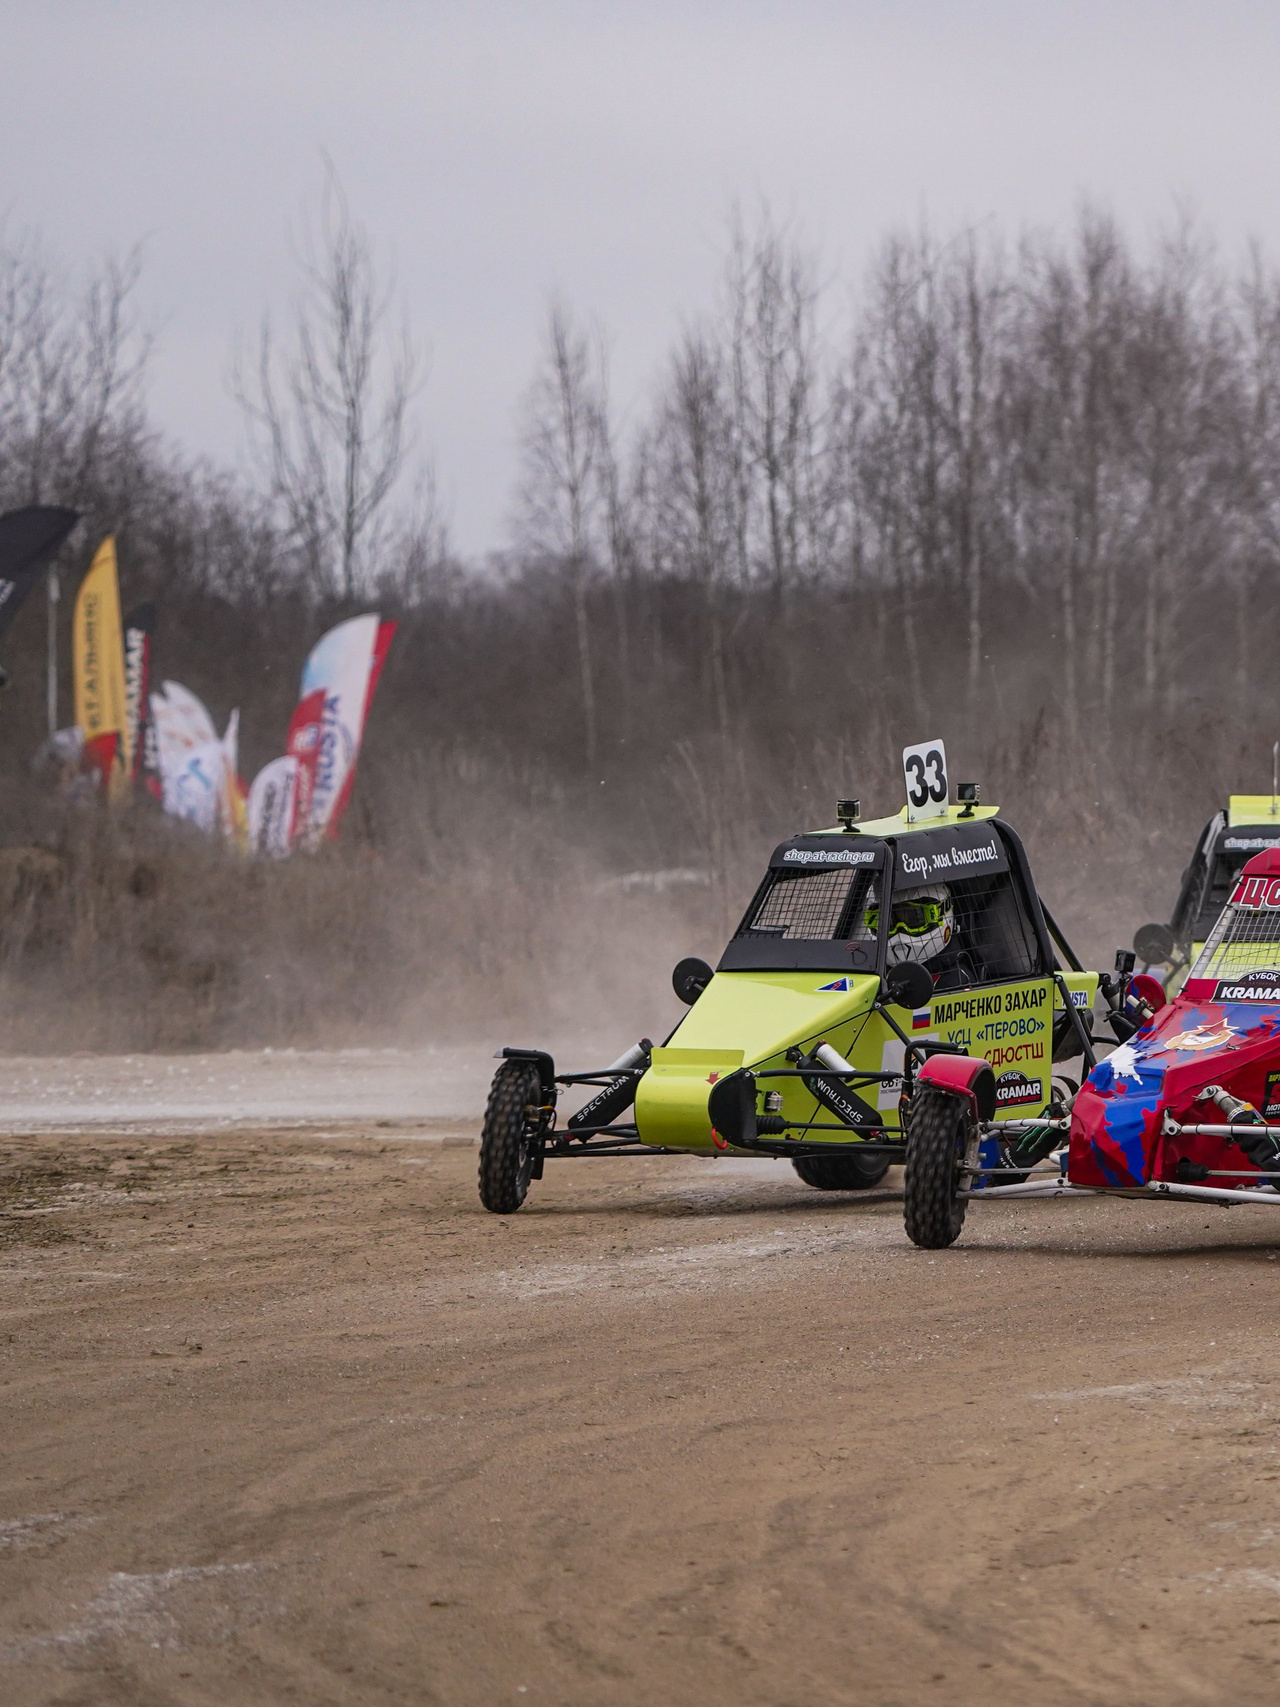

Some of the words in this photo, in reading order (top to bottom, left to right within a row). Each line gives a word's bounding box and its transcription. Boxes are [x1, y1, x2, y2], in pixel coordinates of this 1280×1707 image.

[905, 750, 947, 808] 33
[784, 849, 875, 864] shop.at-racing.ru
[901, 852, 932, 879] Егор,
[933, 852, 952, 869] мы
[952, 840, 998, 867] вместе!
[1249, 971, 1278, 981] КУБОК
[934, 995, 1001, 1025] МАРЧЕНКО
[1005, 988, 1047, 1013] ЗАХАР
[947, 1027, 971, 1046] УСЦ
[976, 1017, 1045, 1042] «ПЕРОВО»
[984, 1042, 1044, 1068] СДЮСТШ
[996, 1082, 1041, 1100] KRAMAR
[1000, 1072, 1021, 1084] КУБОК
[816, 1077, 864, 1124] SPECTRUM
